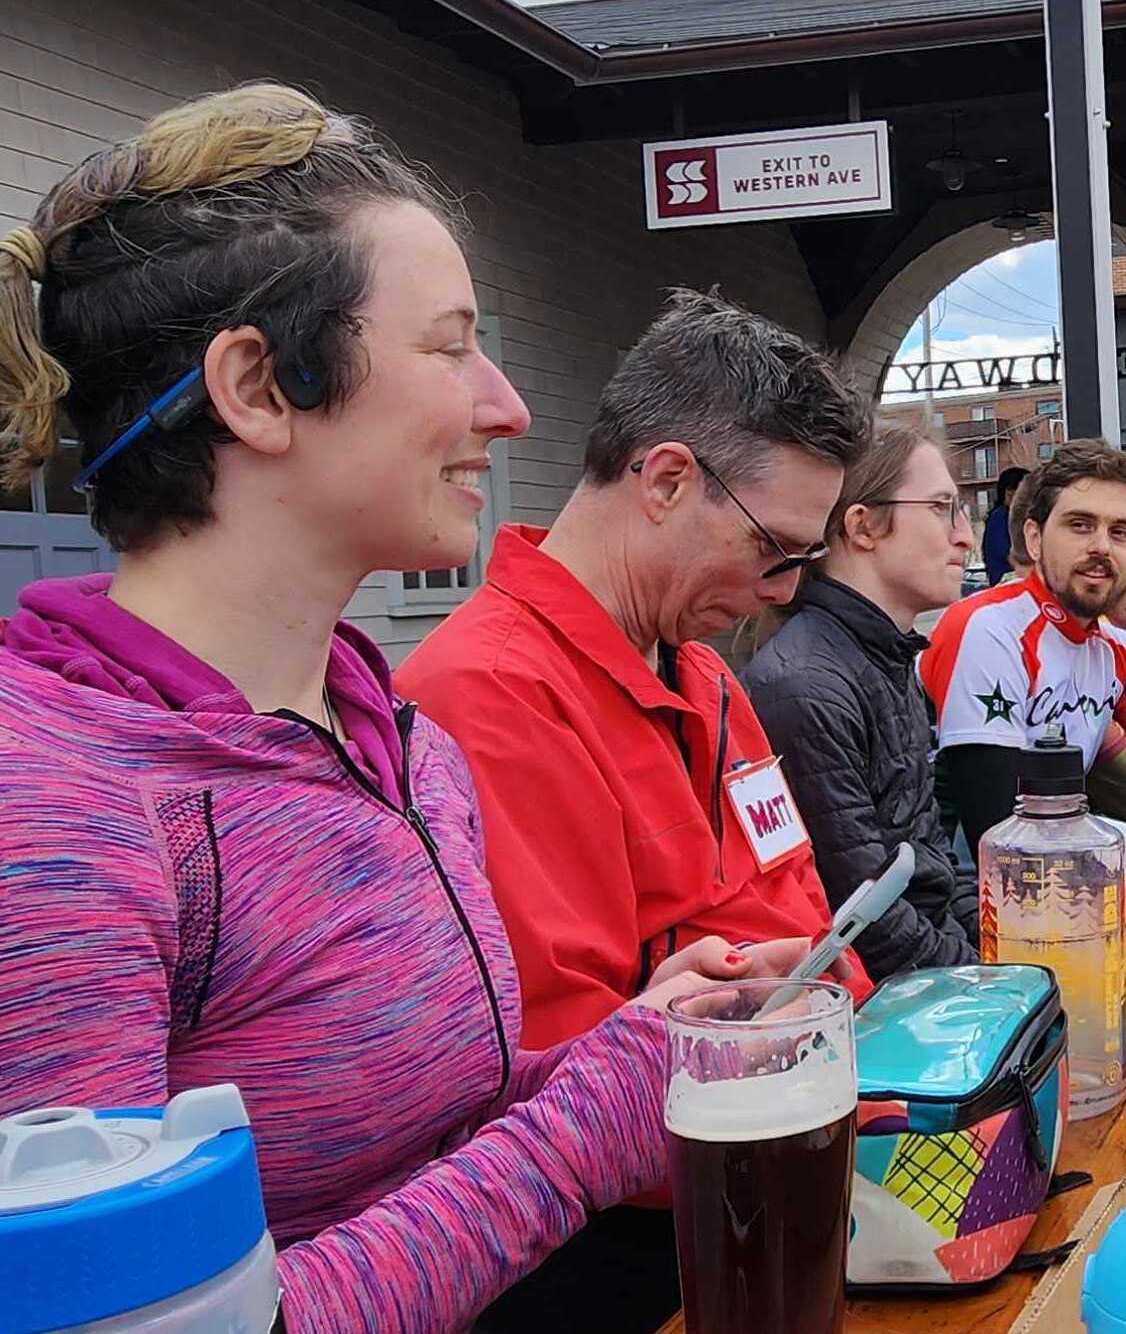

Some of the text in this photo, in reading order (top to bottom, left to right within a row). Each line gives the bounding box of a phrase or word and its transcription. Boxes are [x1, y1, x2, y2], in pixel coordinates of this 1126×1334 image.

[762, 154, 831, 173] EXIT TO
[733, 169, 862, 193] WESTERN AVE
[745, 793, 793, 838] MATT
